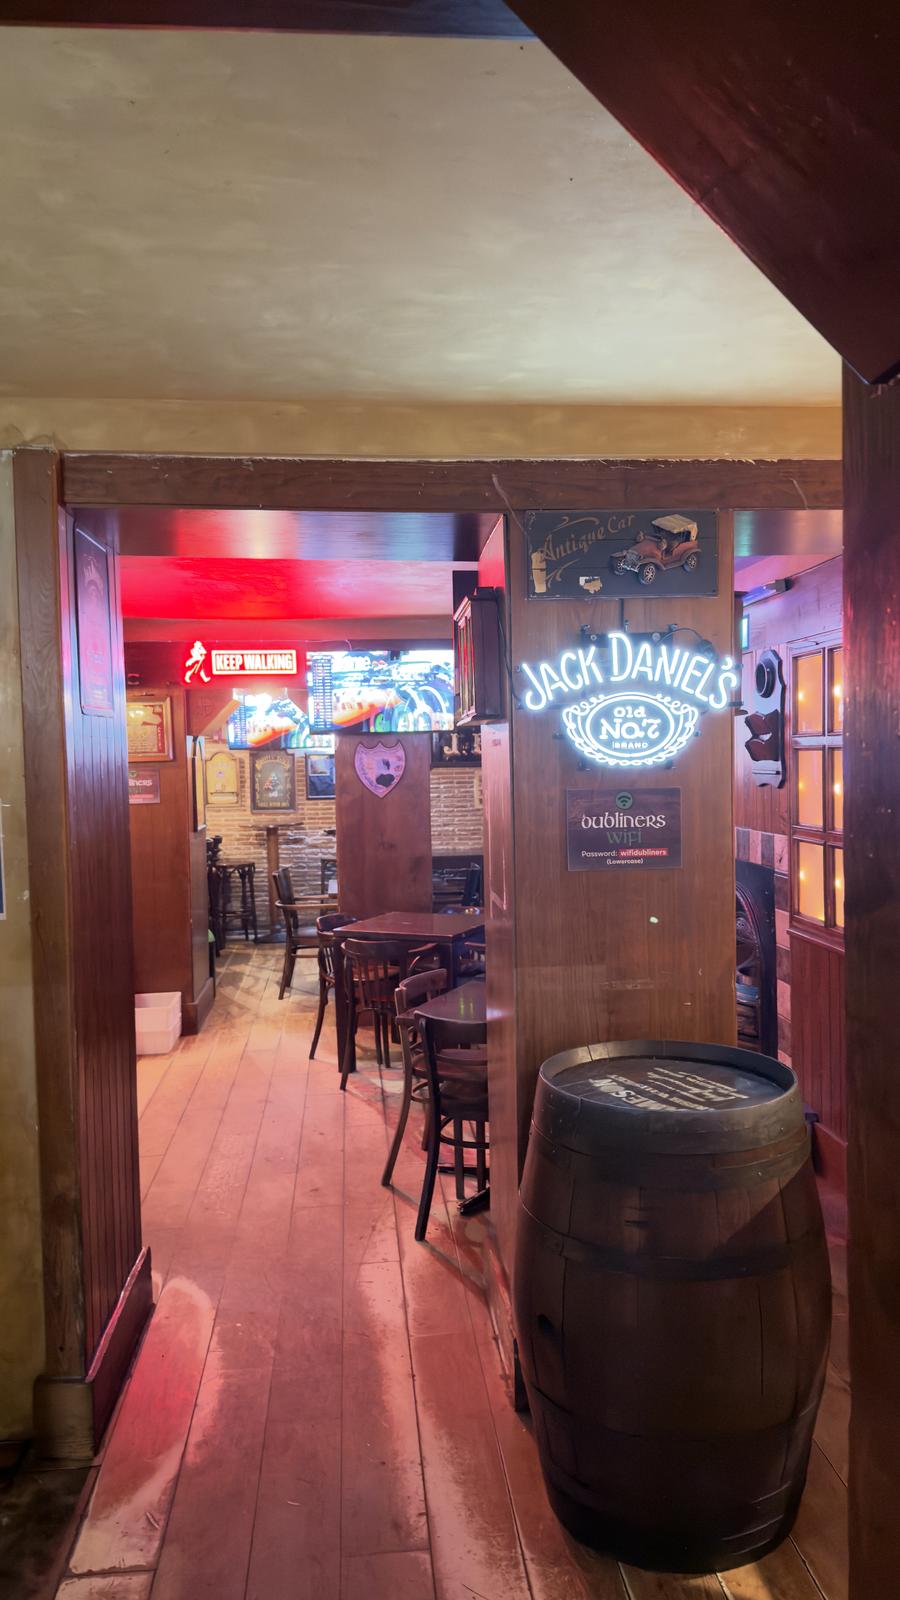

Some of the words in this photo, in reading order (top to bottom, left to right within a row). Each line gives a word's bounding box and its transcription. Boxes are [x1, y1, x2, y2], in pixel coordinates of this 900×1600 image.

[541, 524, 605, 561] Antique
[607, 514, 636, 533] Car
[216, 653, 243, 671] KEEP
[244, 653, 293, 671] WALKING
[522, 645, 604, 711] JACK
[613, 741, 649, 749] BRAND
[581, 849, 617, 858] Password:
[620, 848, 667, 857] wifidubliners
